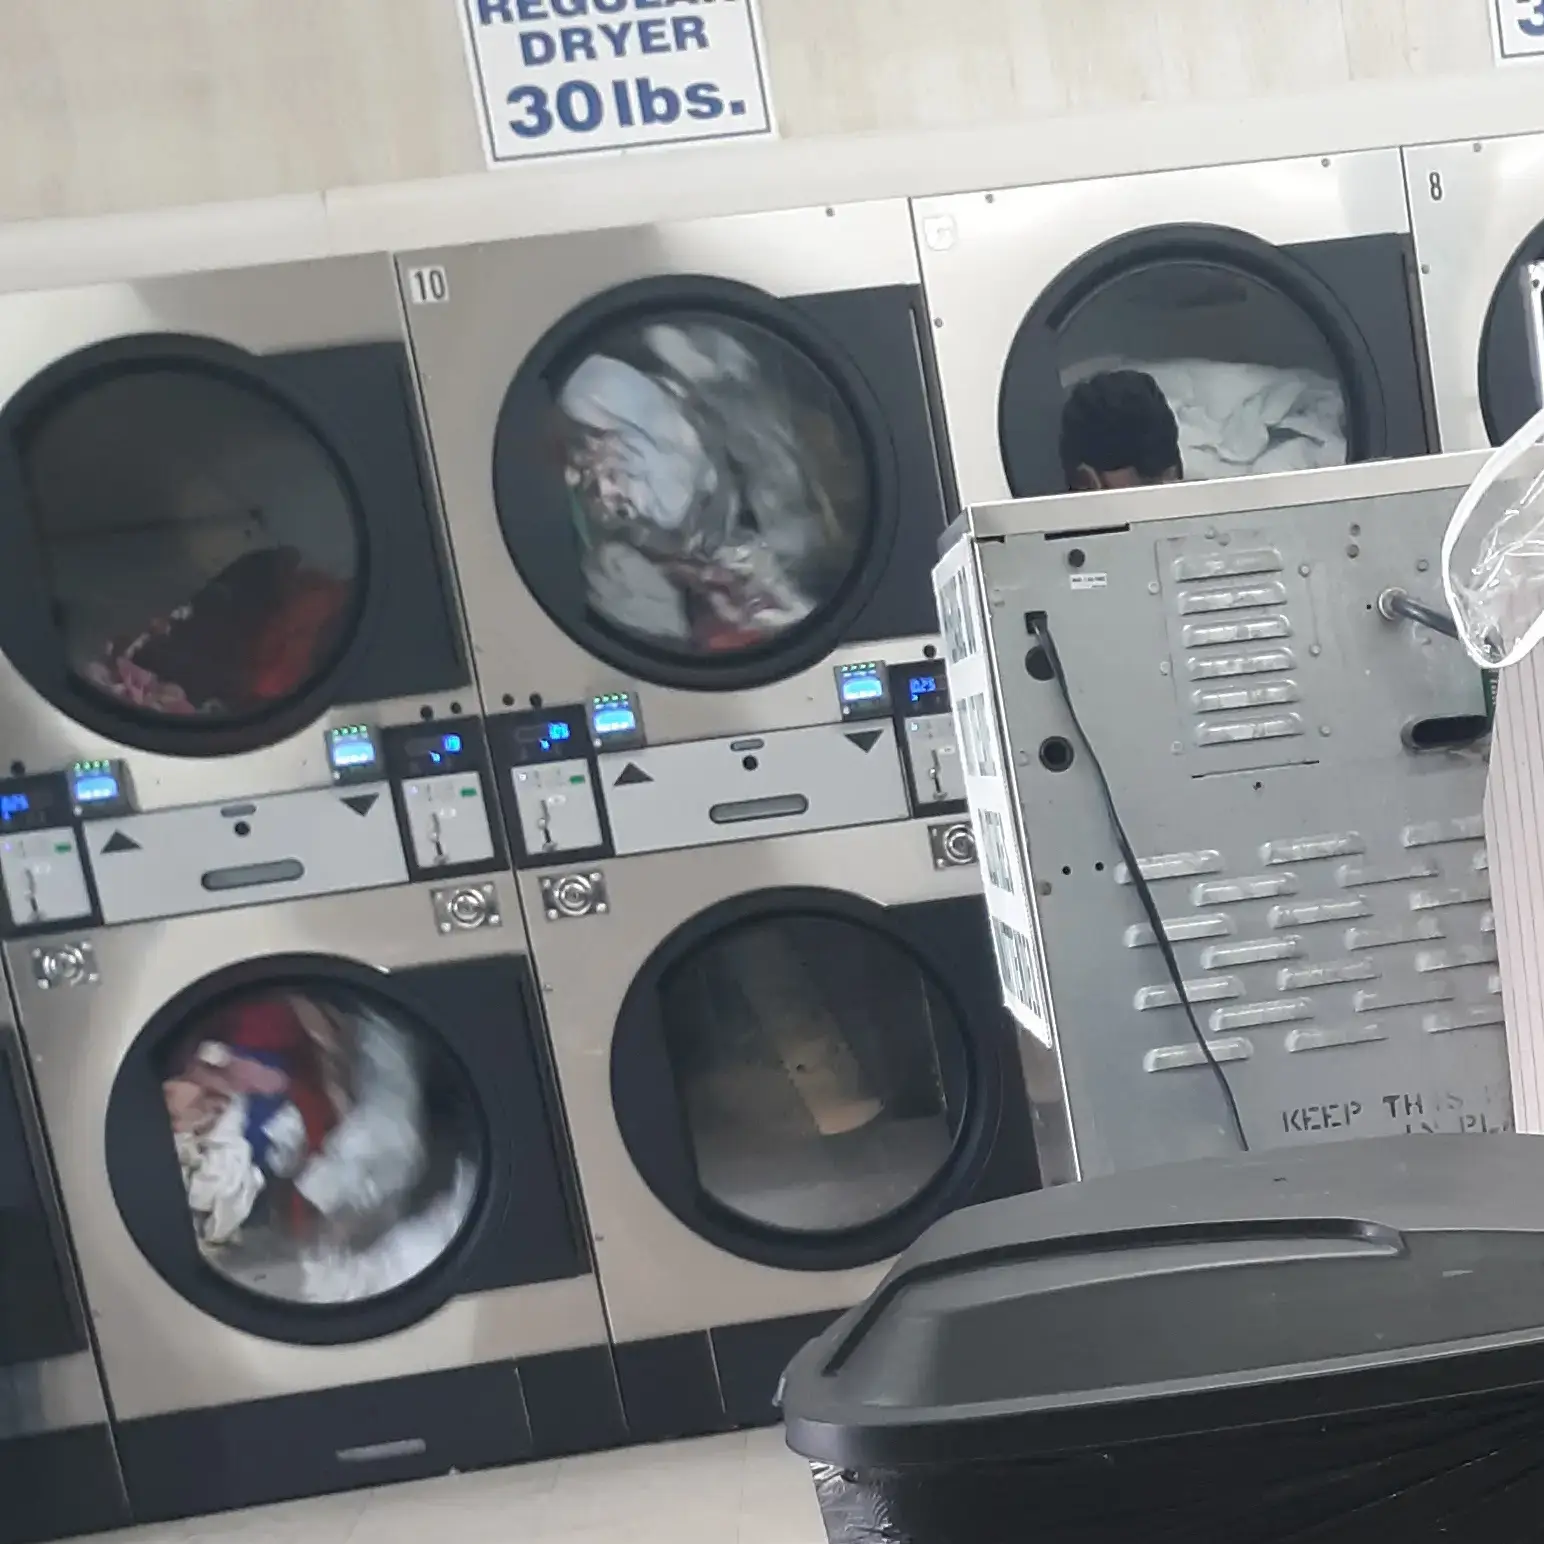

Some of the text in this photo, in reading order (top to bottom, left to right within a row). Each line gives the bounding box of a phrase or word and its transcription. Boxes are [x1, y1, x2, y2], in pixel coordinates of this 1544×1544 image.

[519, 15, 710, 67] DRYER
[1429, 171, 1442, 201] 8
[415, 270, 445, 301] 10
[1282, 1101, 1361, 1132] KEEP
